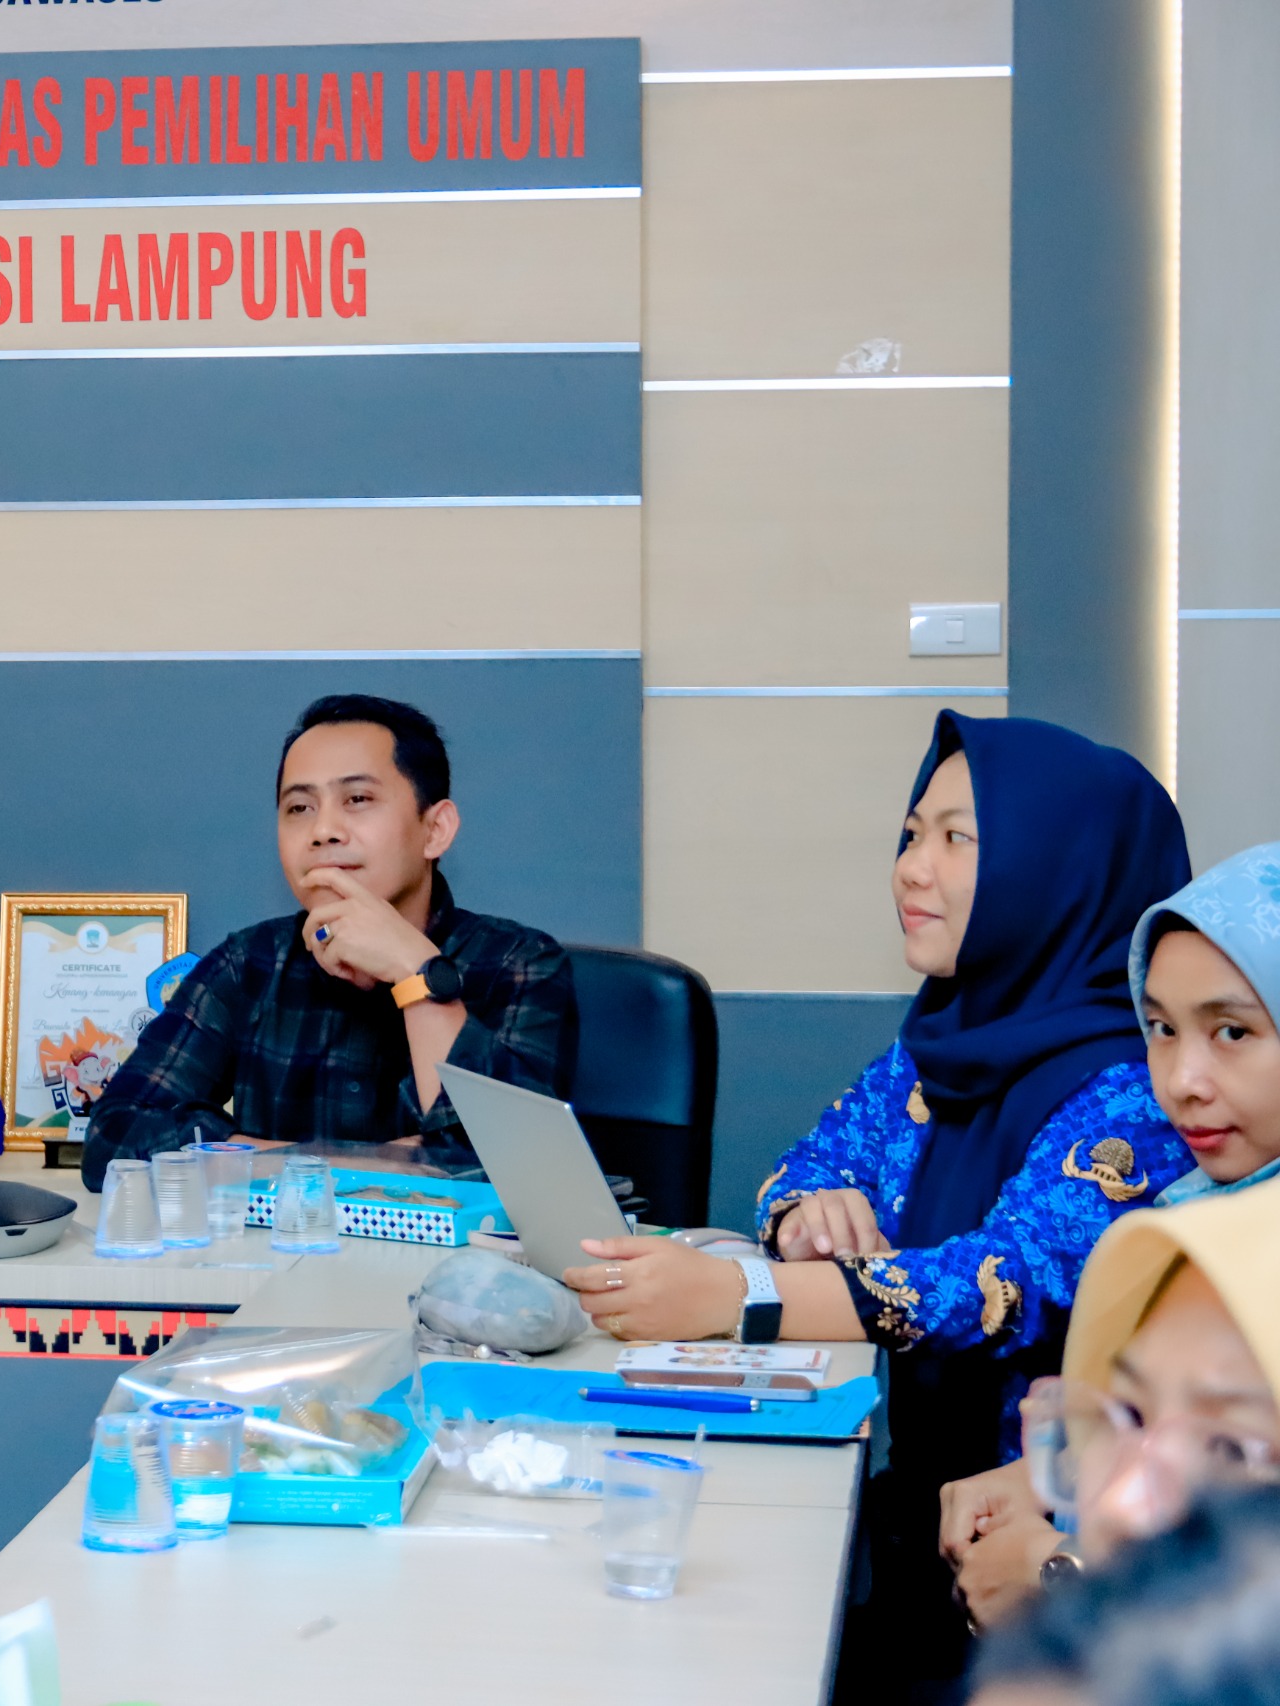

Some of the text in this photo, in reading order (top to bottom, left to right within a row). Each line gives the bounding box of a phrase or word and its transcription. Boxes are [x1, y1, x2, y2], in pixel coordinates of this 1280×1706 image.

[84, 71, 384, 166] PEMILIHAN
[407, 67, 586, 163] UMUM
[60, 227, 367, 323] LAMPUNG
[61, 963, 121, 972] CERTIFICATE
